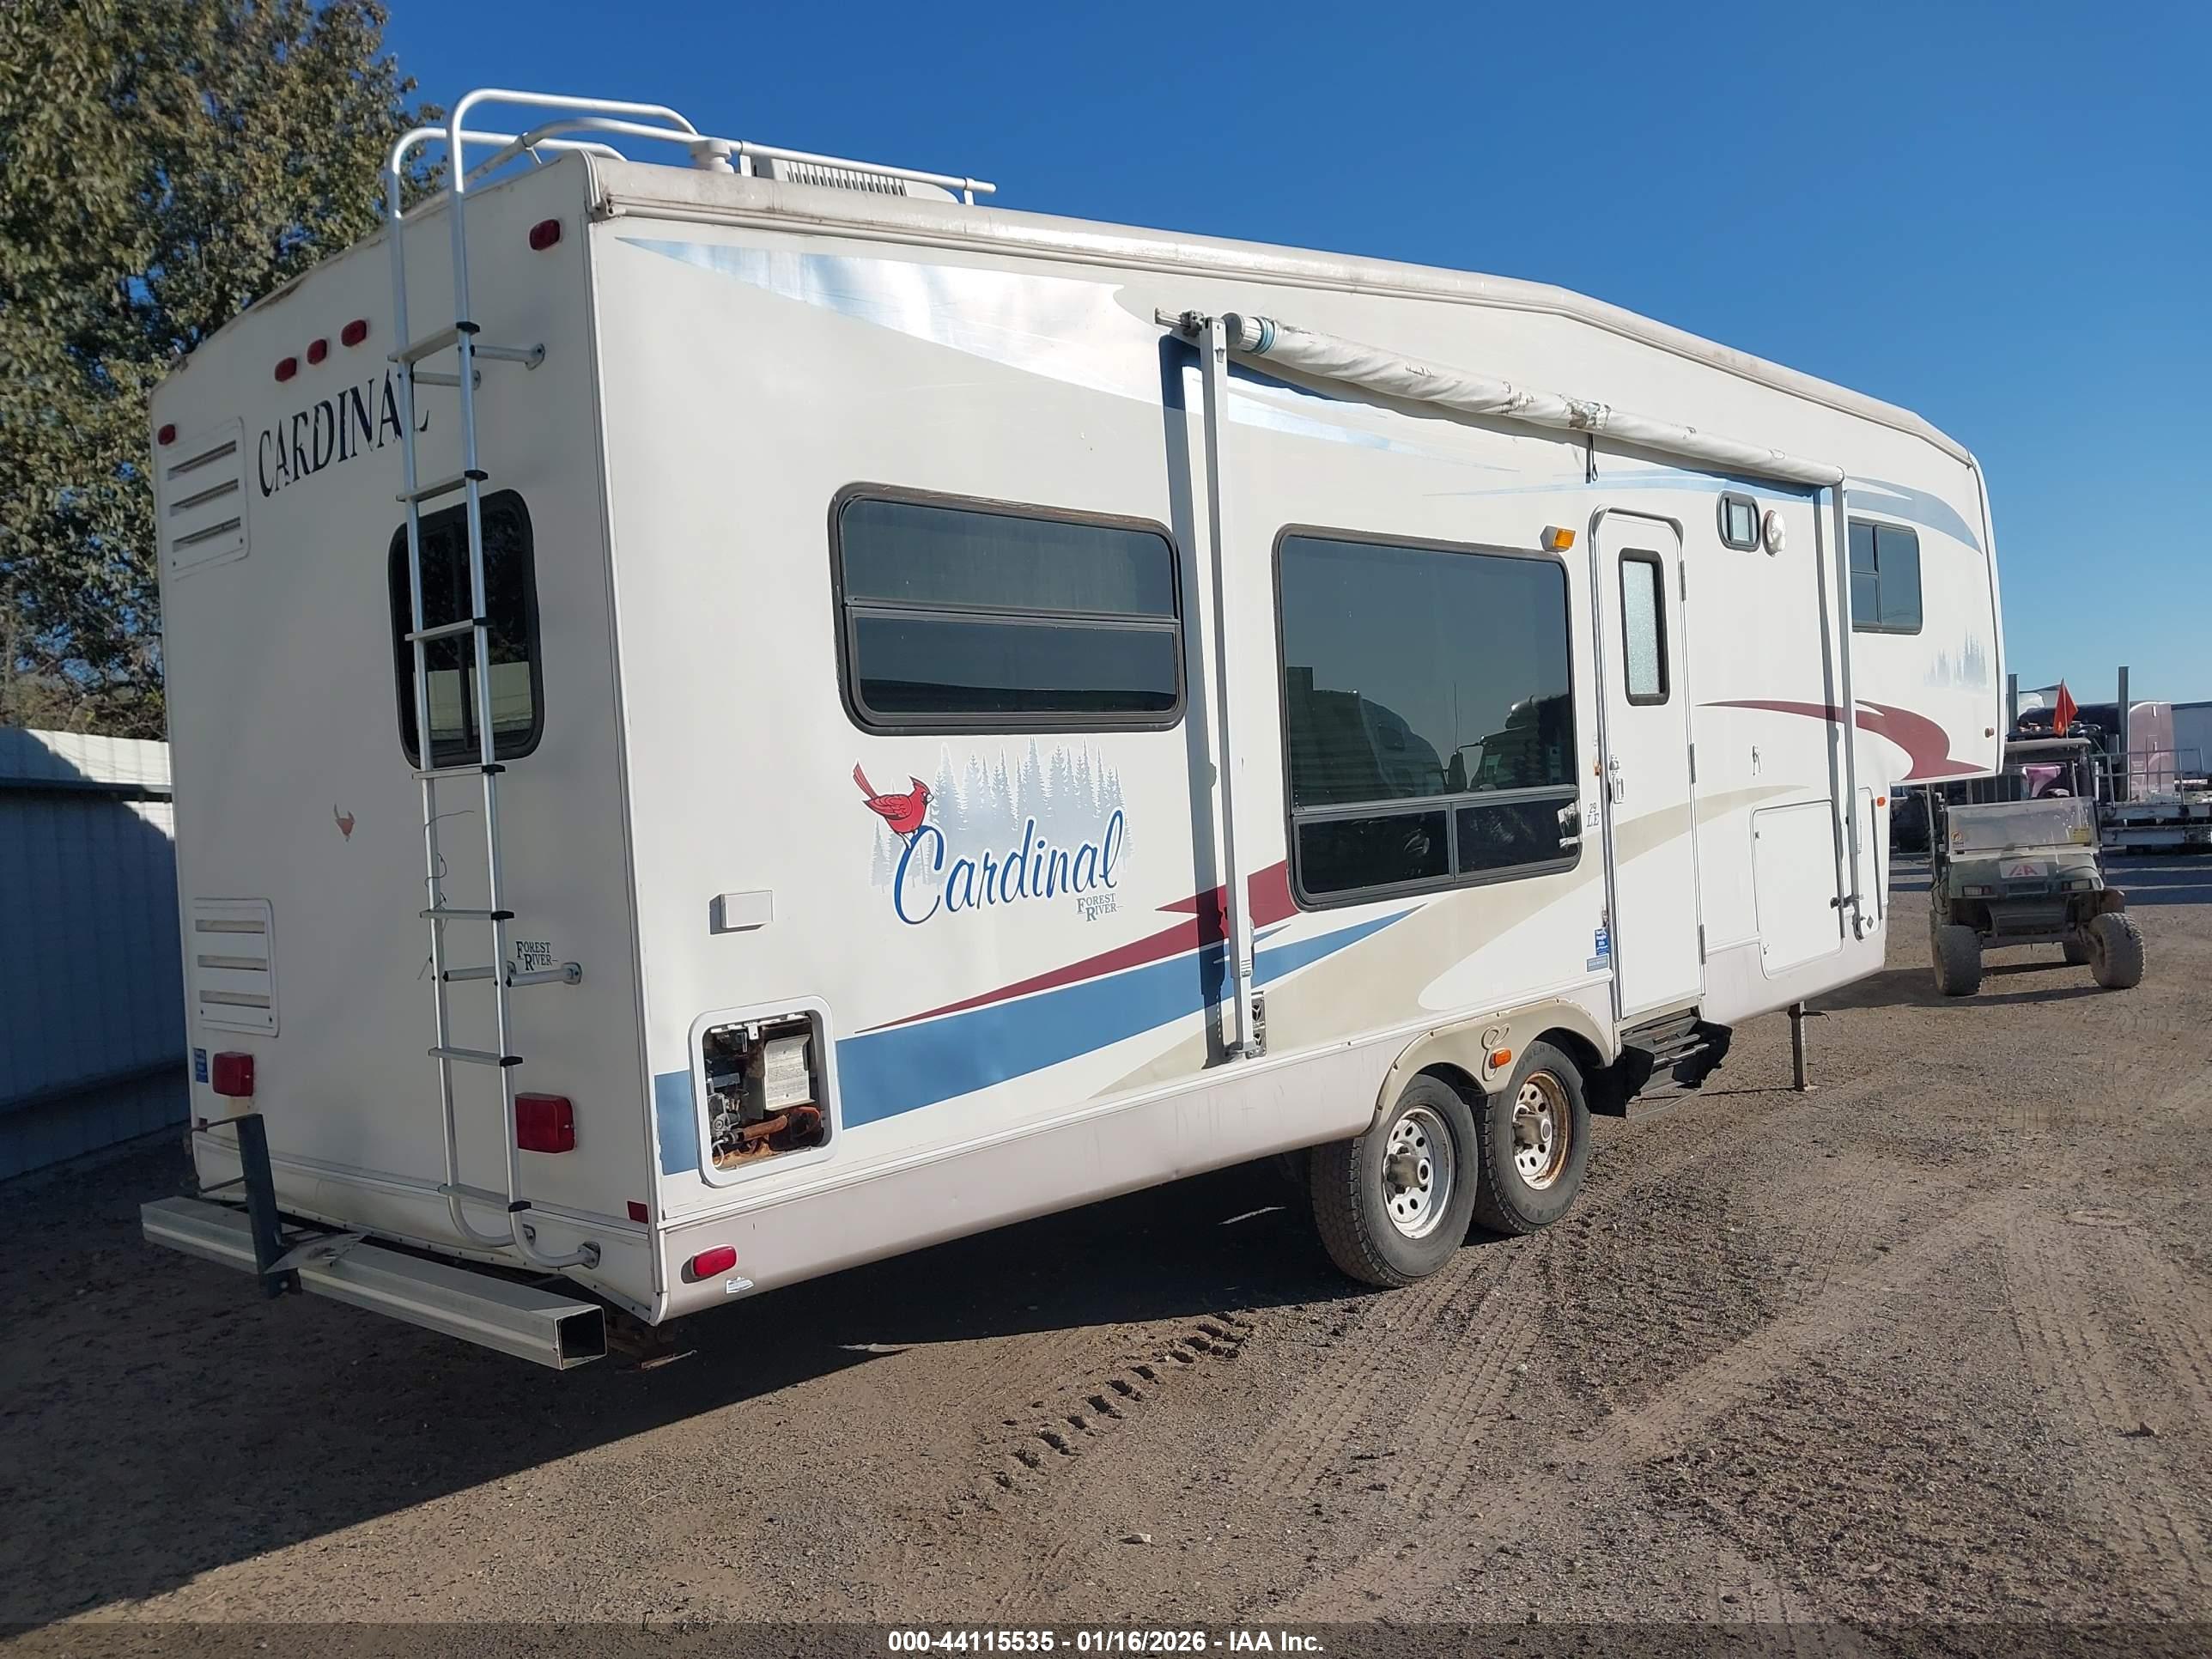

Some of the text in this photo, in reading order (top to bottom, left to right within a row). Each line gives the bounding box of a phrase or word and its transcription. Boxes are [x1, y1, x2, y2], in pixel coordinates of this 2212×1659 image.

[258, 368, 429, 498] CARDINAL
[1589, 802, 1597, 813] 29
[1587, 813, 1599, 827] LE
[893, 810, 1124, 926] Cardinal
[1077, 893, 1116, 914] FOREST
[1085, 903, 1118, 922] RIVER
[515, 940, 551, 958] FOREST
[524, 953, 552, 971] RIVER
